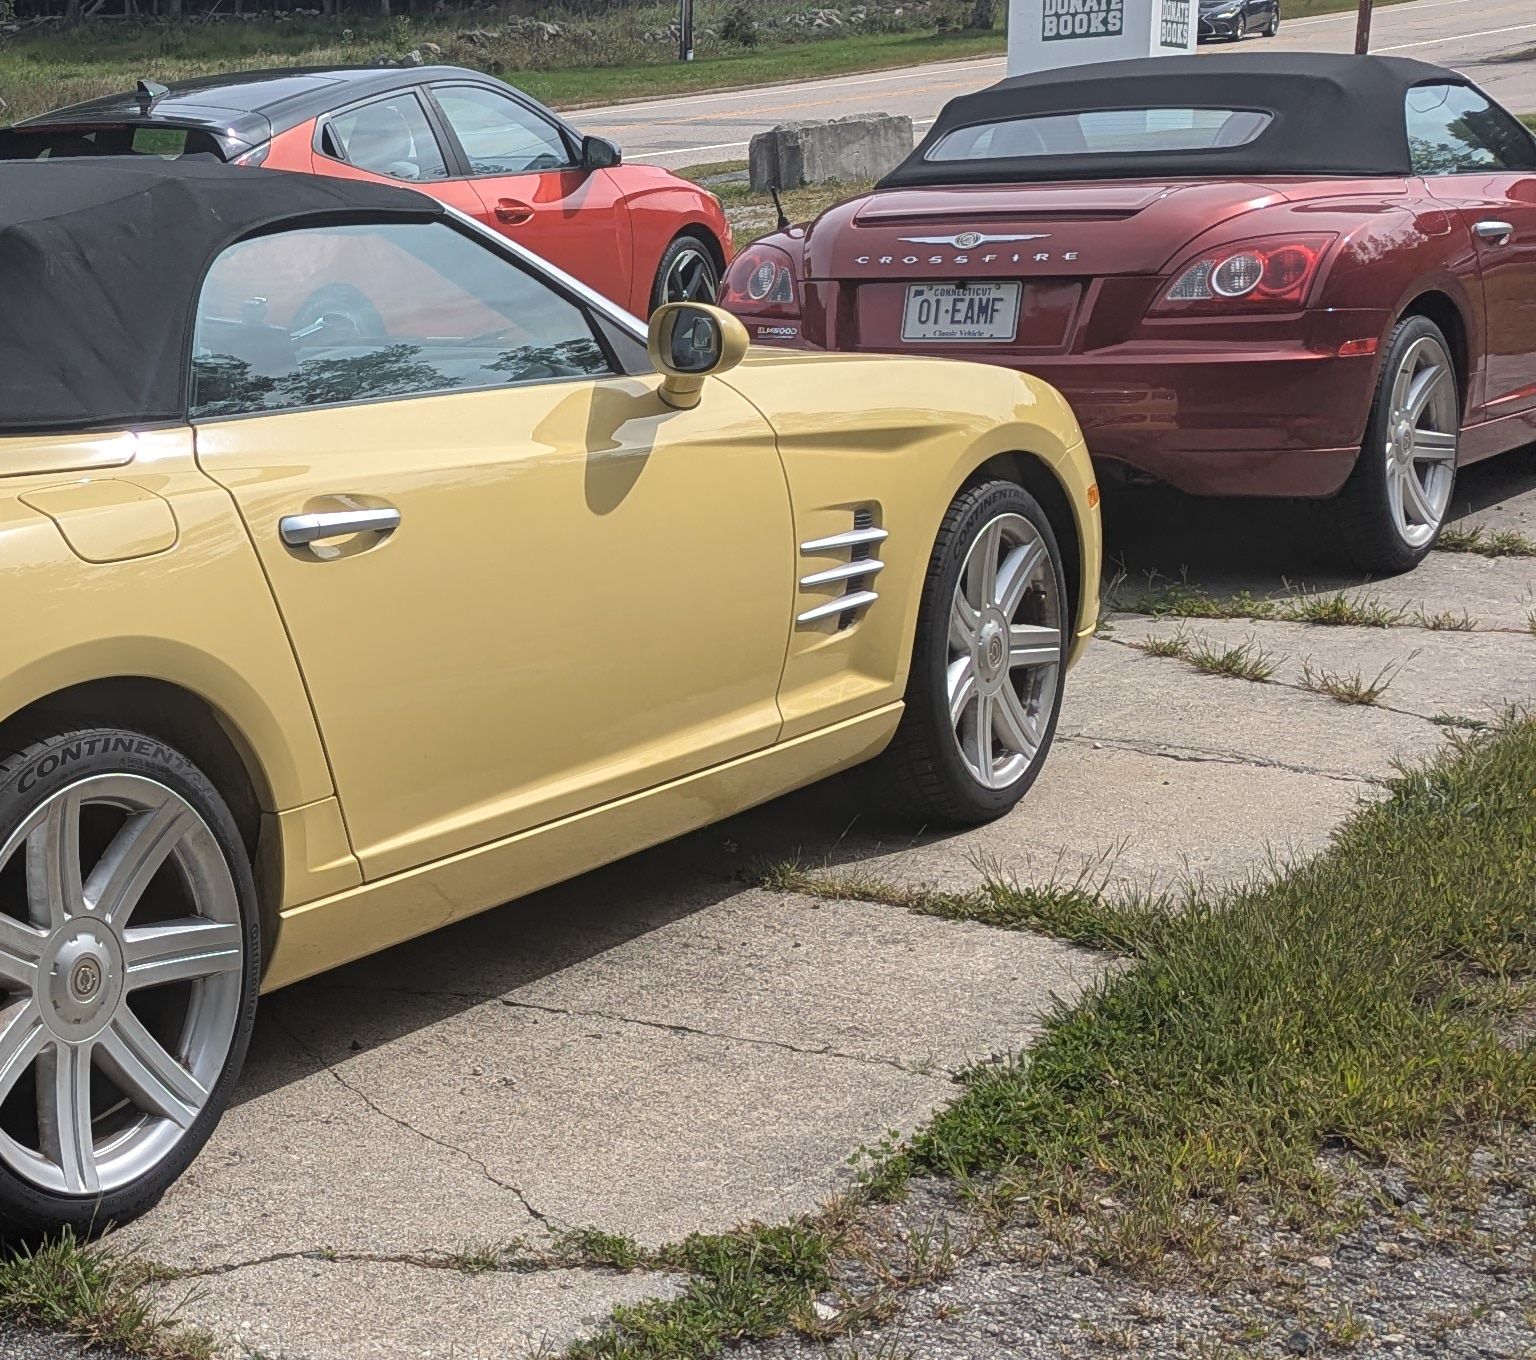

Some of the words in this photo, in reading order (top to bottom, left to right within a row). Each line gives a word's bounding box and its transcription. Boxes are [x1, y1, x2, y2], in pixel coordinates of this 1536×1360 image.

[1162, 0, 1190, 23] DONATE
[1044, 10, 1122, 37] BOOKS
[1161, 21, 1188, 45] BOOKS
[854, 251, 1079, 265] CROSSFIRE
[933, 287, 993, 297] CONNECTICUT
